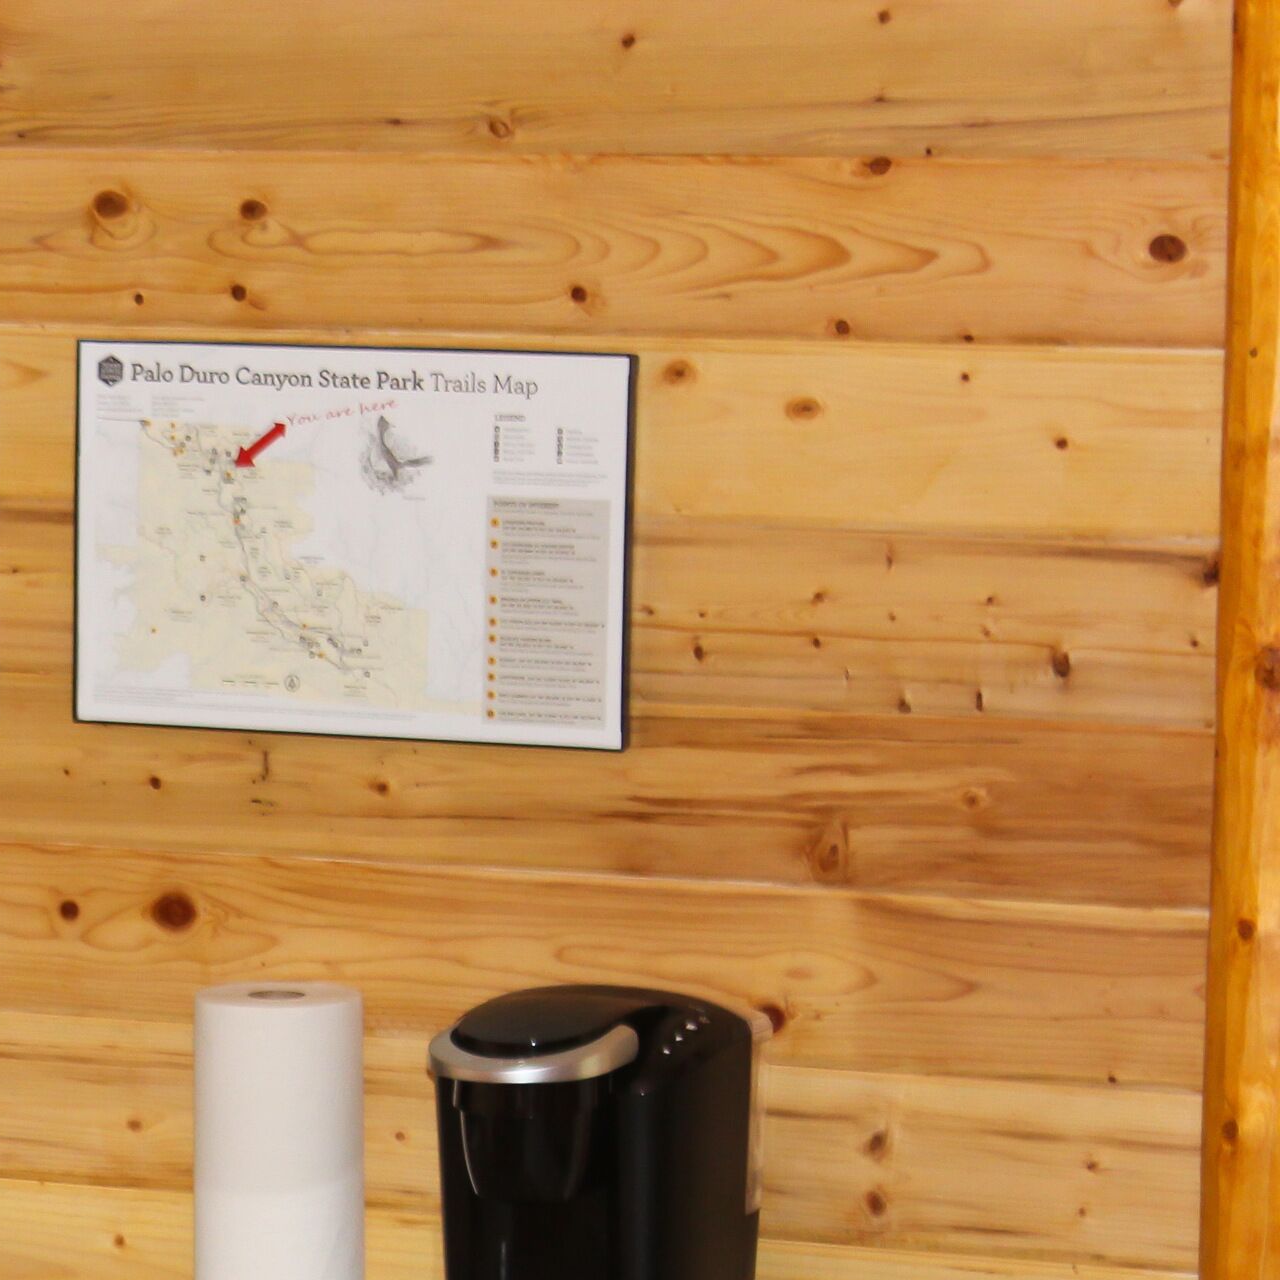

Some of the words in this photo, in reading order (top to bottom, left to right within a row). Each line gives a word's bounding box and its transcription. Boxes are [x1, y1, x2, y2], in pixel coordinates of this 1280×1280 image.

[131, 362, 174, 382] Palo
[179, 364, 231, 384] Duro
[236, 366, 313, 391] Canyon
[319, 369, 371, 389] State
[376, 370, 425, 392] Park
[431, 371, 487, 394] Trails
[493, 374, 540, 400] Map
[360, 399, 399, 416] here
